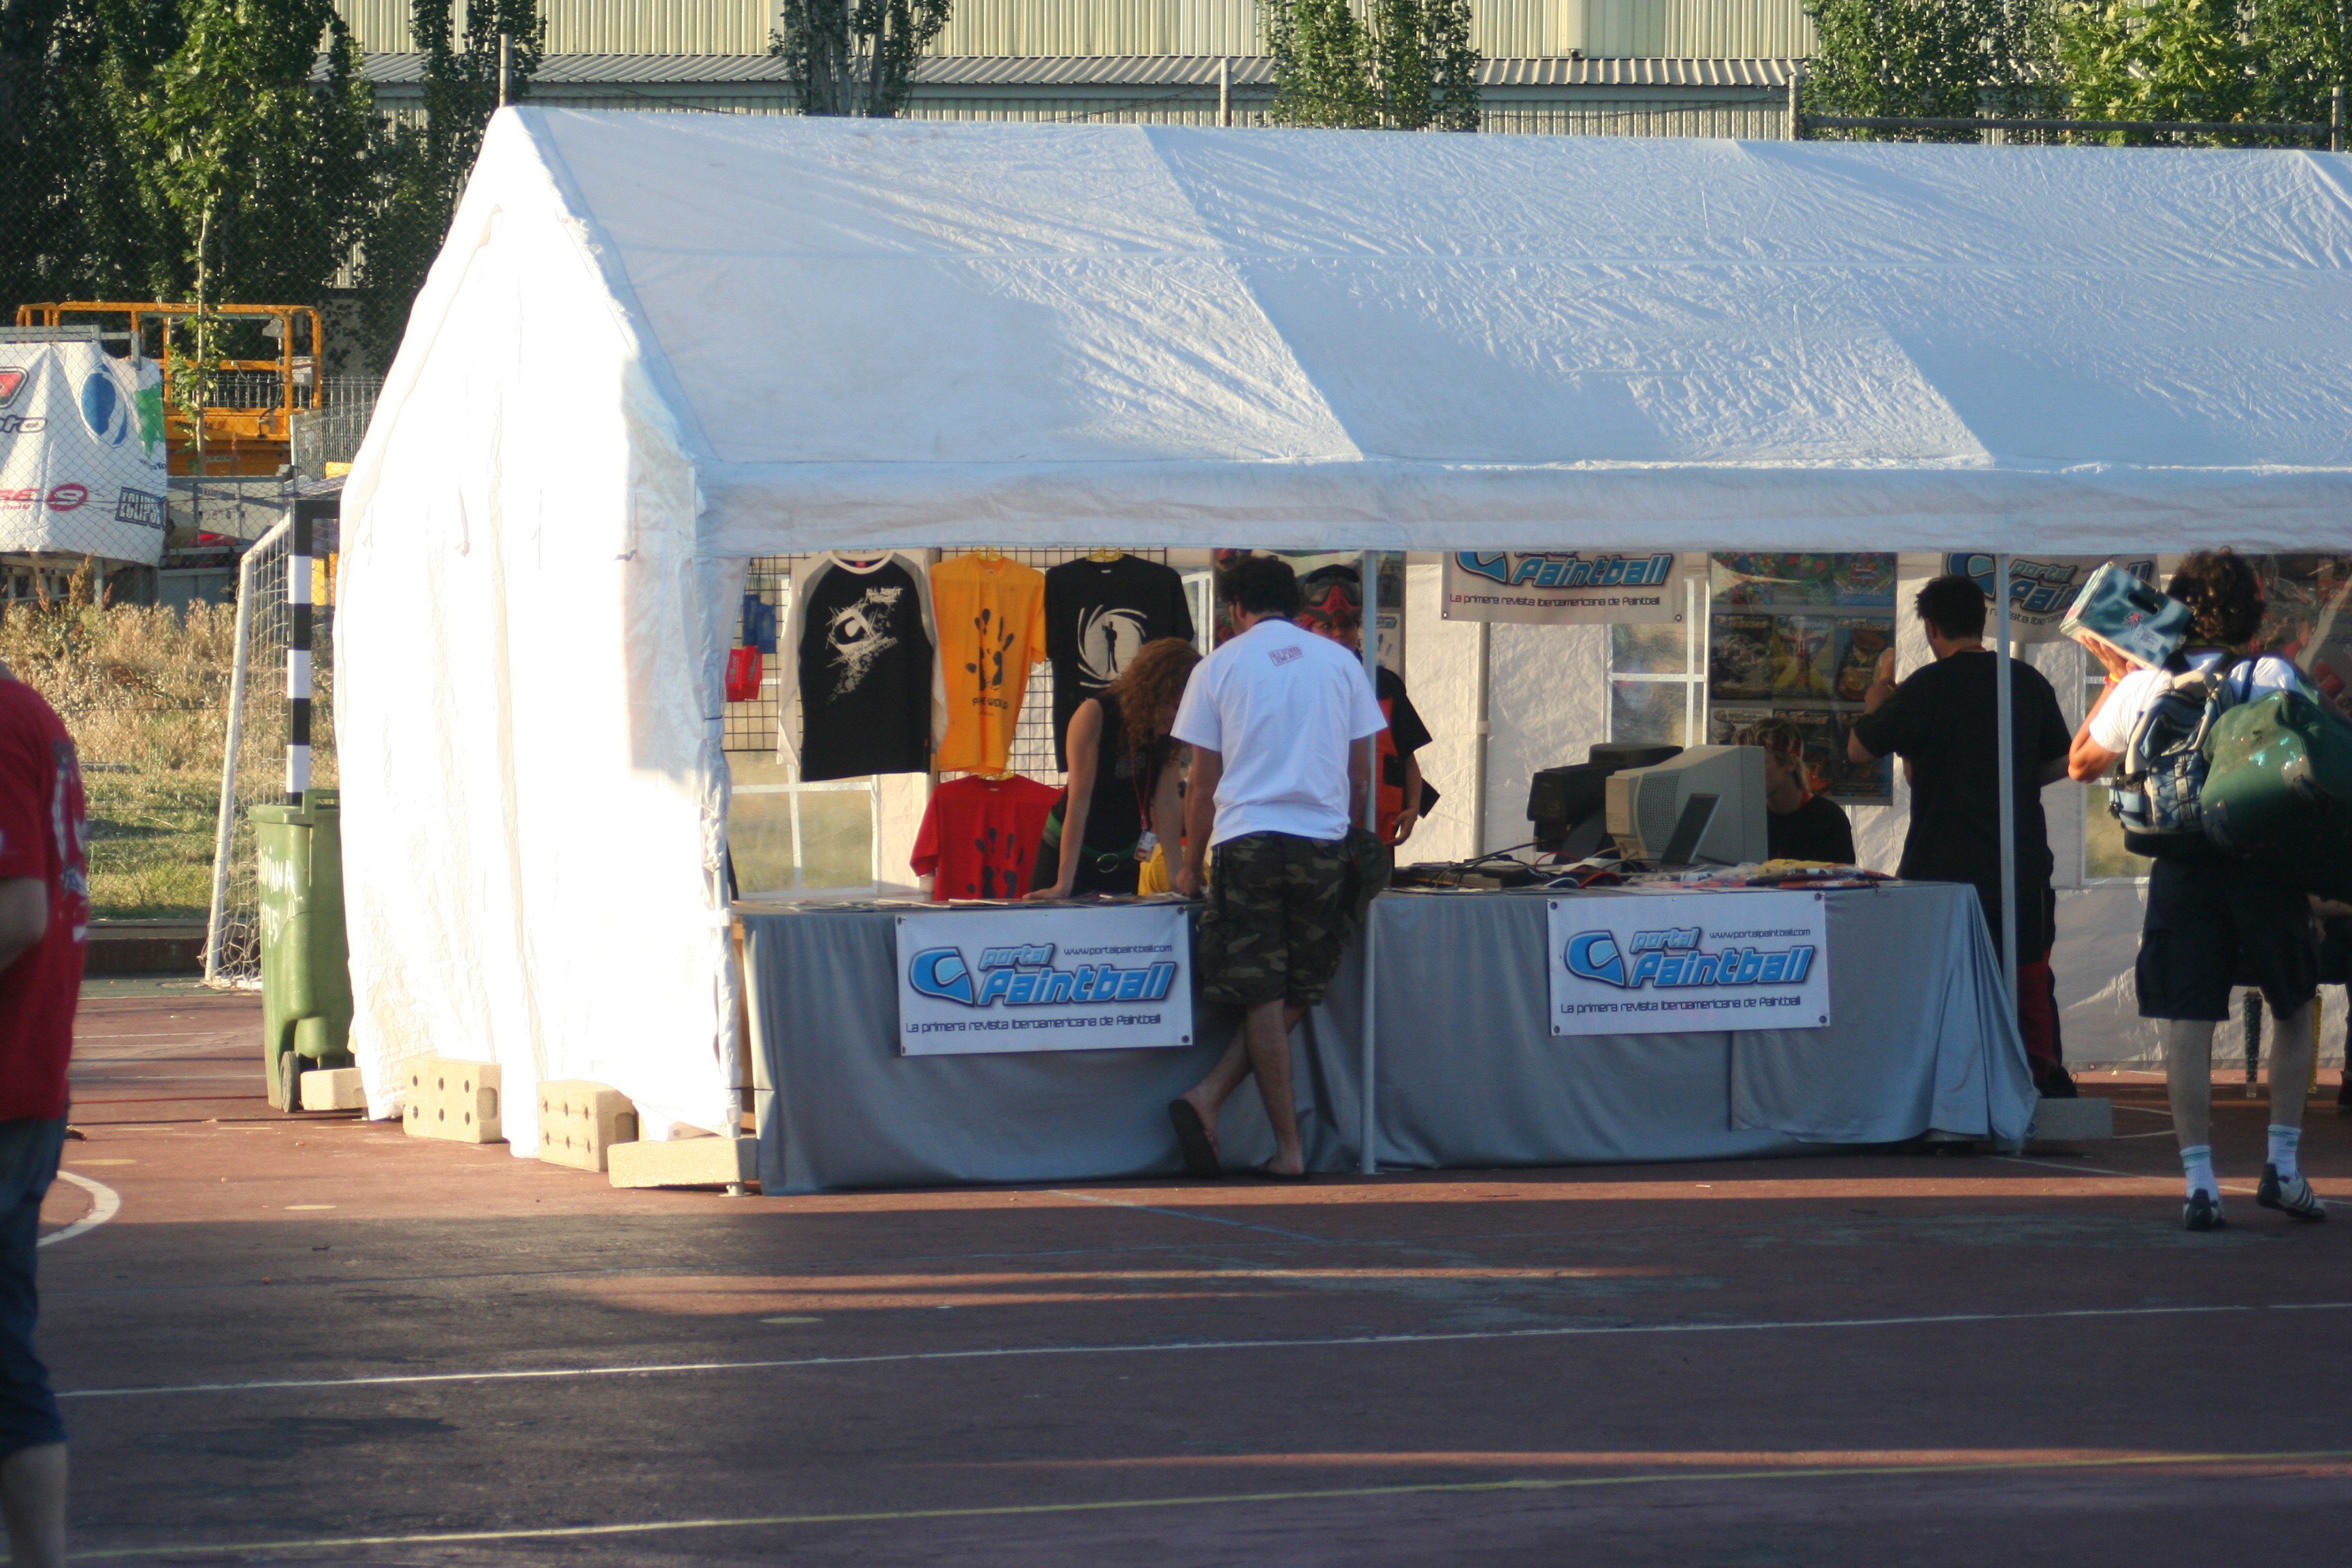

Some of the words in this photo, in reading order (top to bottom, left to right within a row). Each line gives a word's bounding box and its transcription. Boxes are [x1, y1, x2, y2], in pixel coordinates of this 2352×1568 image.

[1508, 553, 1673, 588] Paintball
[2008, 560, 2077, 583] portal
[1450, 594, 1462, 603] La
[1463, 595, 1500, 606] primera
[1501, 596, 1535, 606] revista
[1537, 597, 1607, 607] Iberoamericana
[1608, 598, 1620, 606] de
[1622, 596, 1660, 606] Paintball
[1629, 927, 1702, 953] portal
[1709, 928, 1810, 939] www.portalpaintball.com
[978, 943, 1056, 970] portal
[1064, 944, 1172, 956] www.portalpaintball.com
[1627, 945, 1816, 988] Paintball
[975, 961, 1177, 1007] Paintball
[1561, 1004, 1574, 1014] La
[1576, 1002, 1618, 1016] primera
[1620, 1000, 1659, 1012] revista
[1661, 998, 1742, 1011] Iberoamericana
[1744, 998, 1757, 1008] de
[1760, 996, 1801, 1008] Paintball
[906, 1023, 919, 1033] La
[921, 1019, 965, 1034] primera
[968, 1018, 1009, 1030] revista
[1012, 1017, 1096, 1030] Iberoamericana
[1099, 1015, 1113, 1026] de
[1116, 1013, 1161, 1026] Paintball
